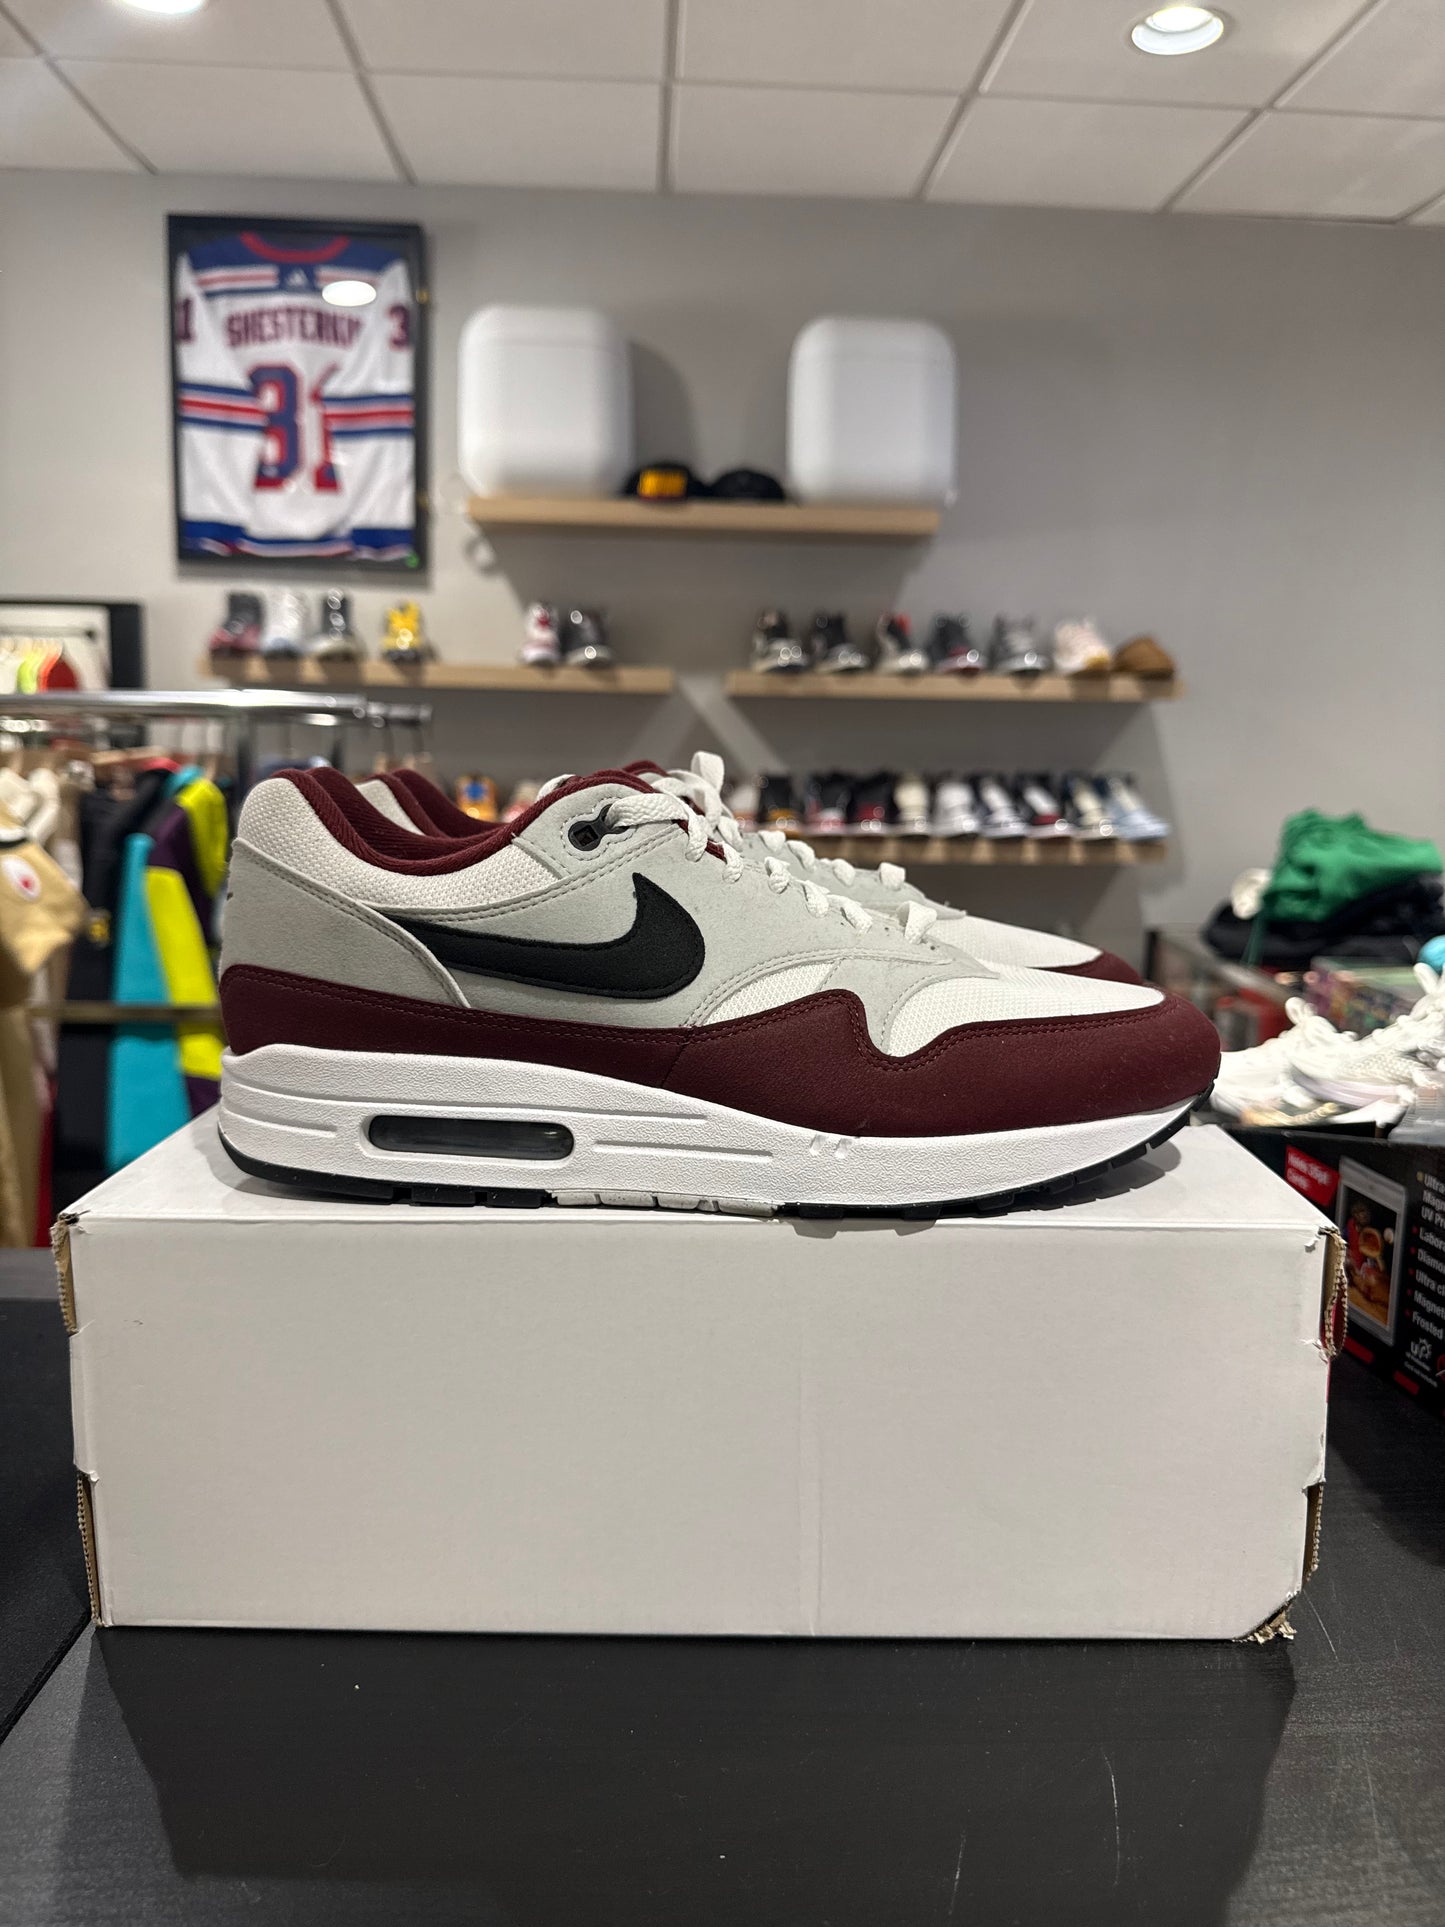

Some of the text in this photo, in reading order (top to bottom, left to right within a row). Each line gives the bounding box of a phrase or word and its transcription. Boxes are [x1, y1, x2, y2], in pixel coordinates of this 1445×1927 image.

[1421, 1205, 1445, 1230] UV Pr
[1415, 1268, 1437, 1293] Ultra
[1412, 1310, 1444, 1341] Frosted
